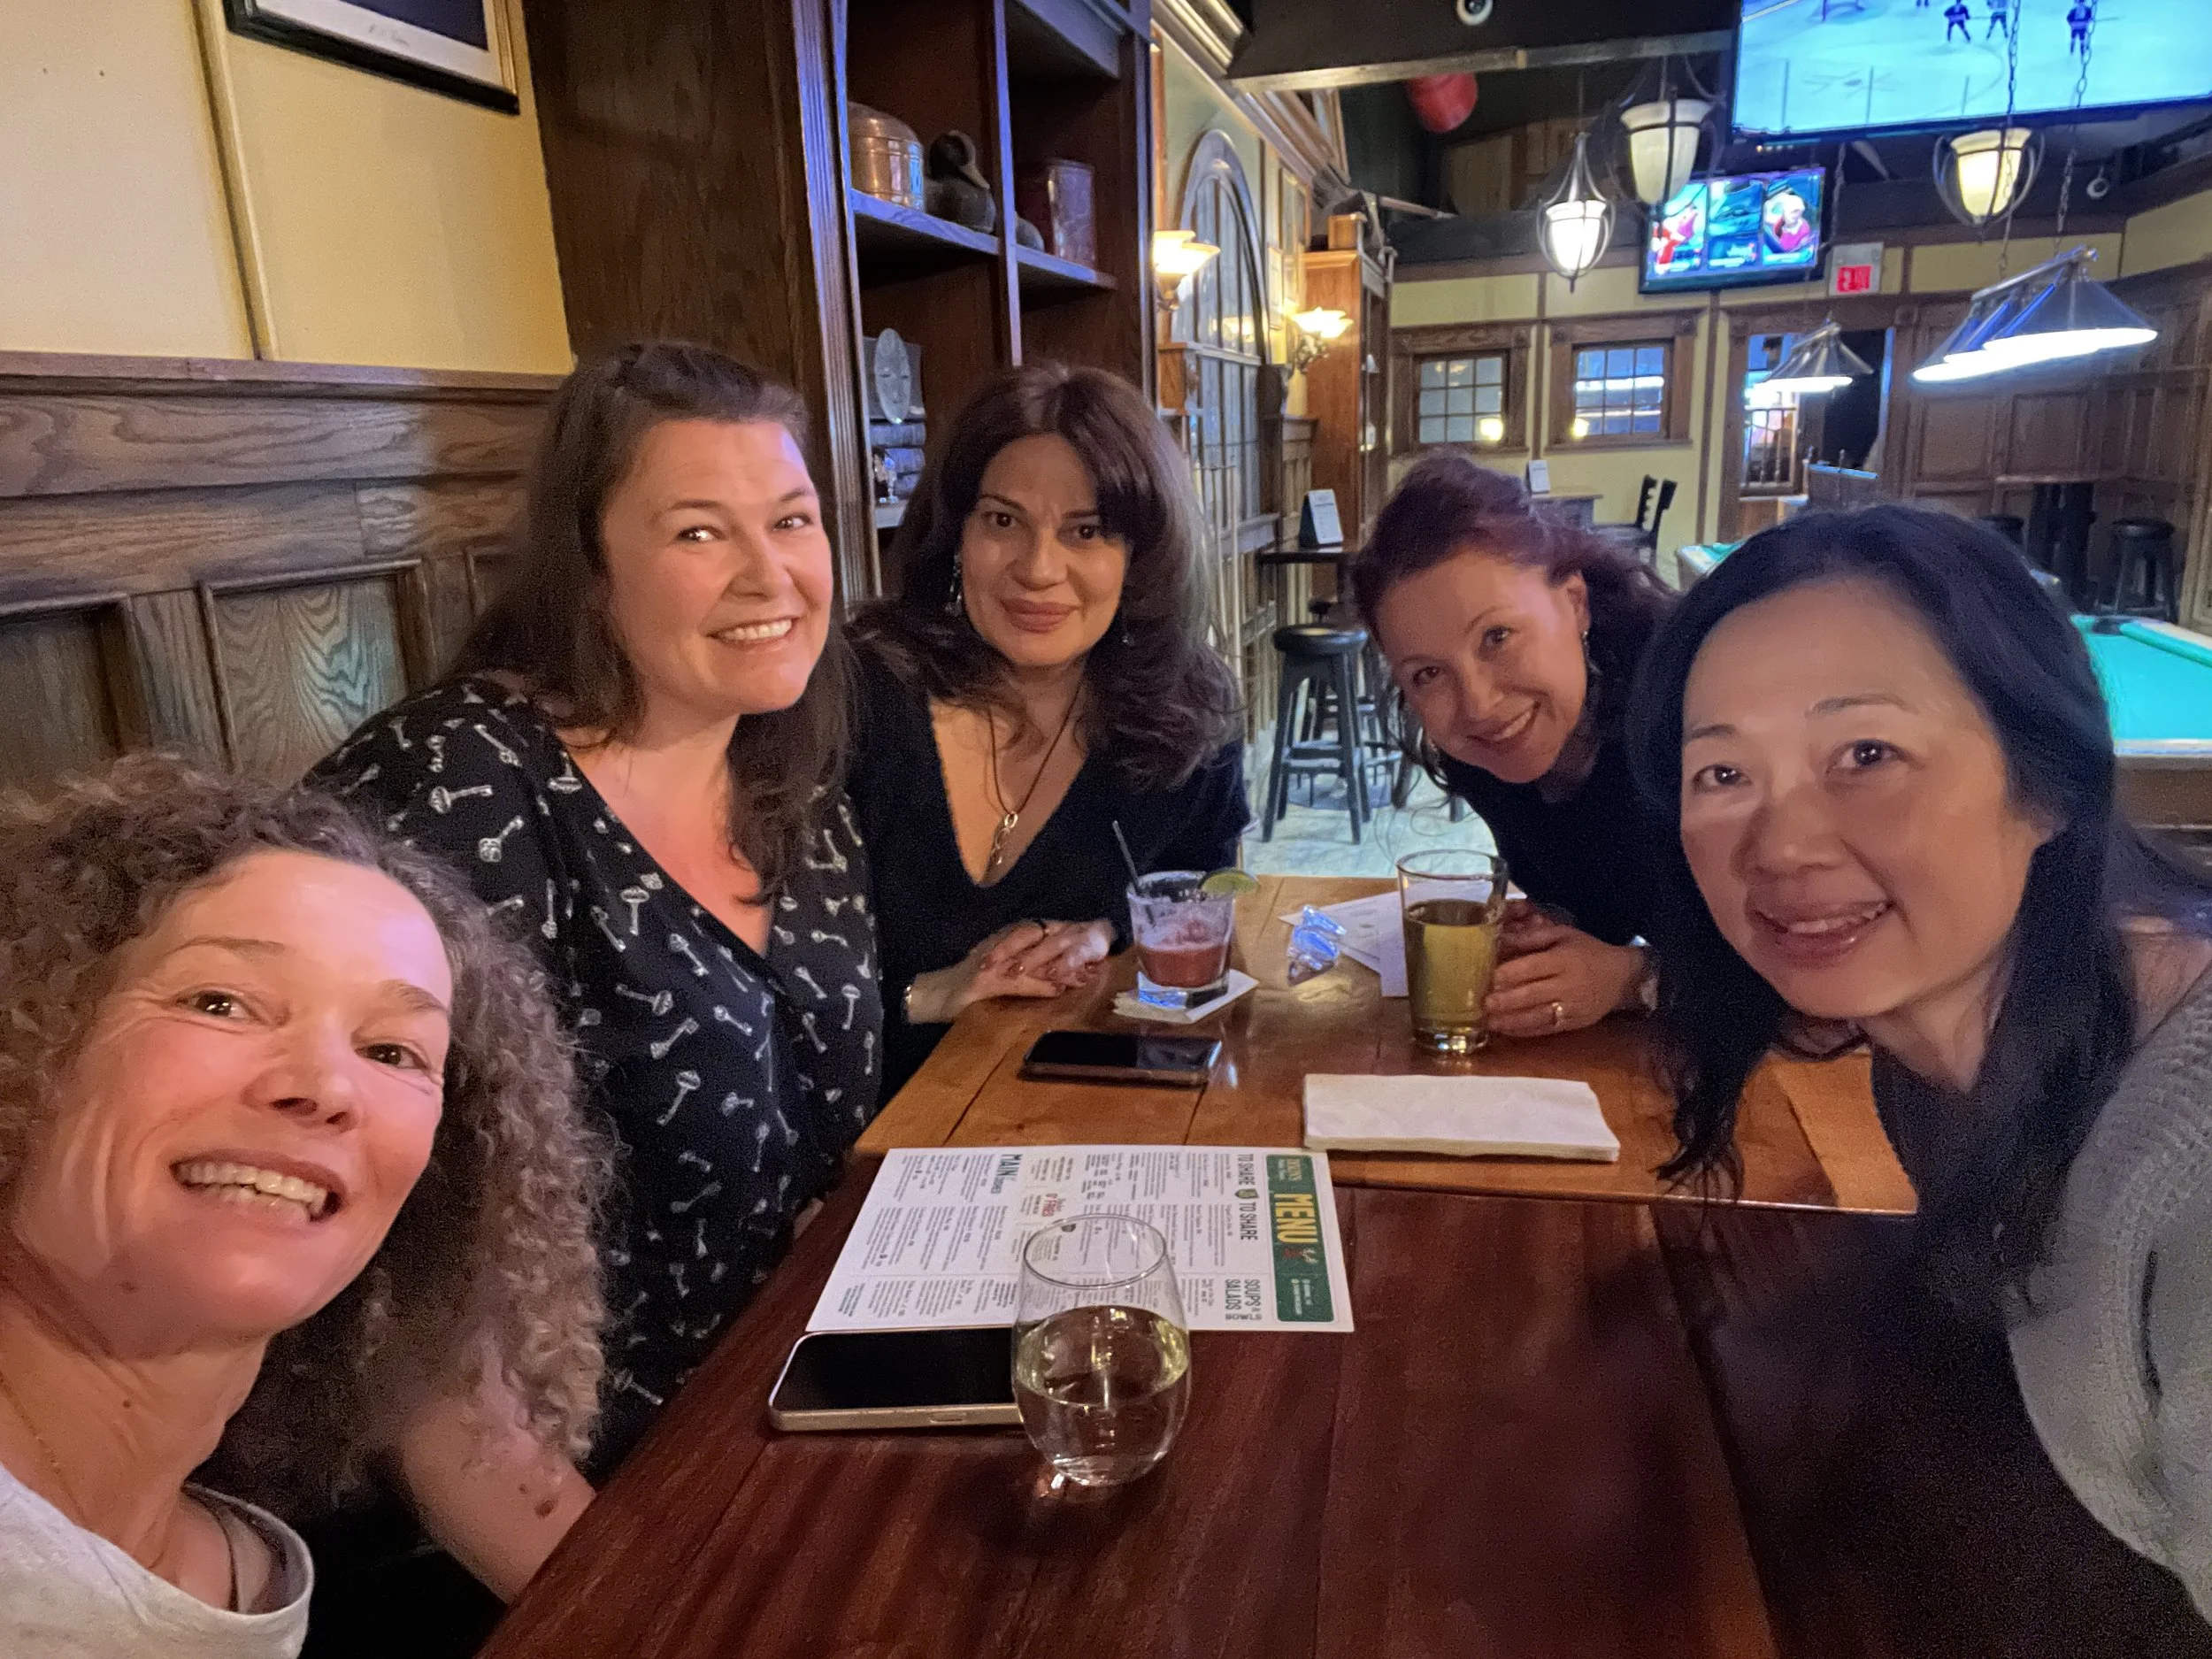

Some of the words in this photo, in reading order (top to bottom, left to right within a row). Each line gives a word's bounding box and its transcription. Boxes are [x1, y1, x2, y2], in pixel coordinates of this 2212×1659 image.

[996, 1154, 1024, 1176] MAIN
[1238, 1163, 1255, 1186] SHARE
[1239, 1202, 1256, 1212] TO
[1273, 1193, 1318, 1243] MENU
[1240, 1213, 1257, 1240] SHARE
[1225, 1279, 1241, 1310] SALADS
[1244, 1279, 1261, 1306] SOUPS
